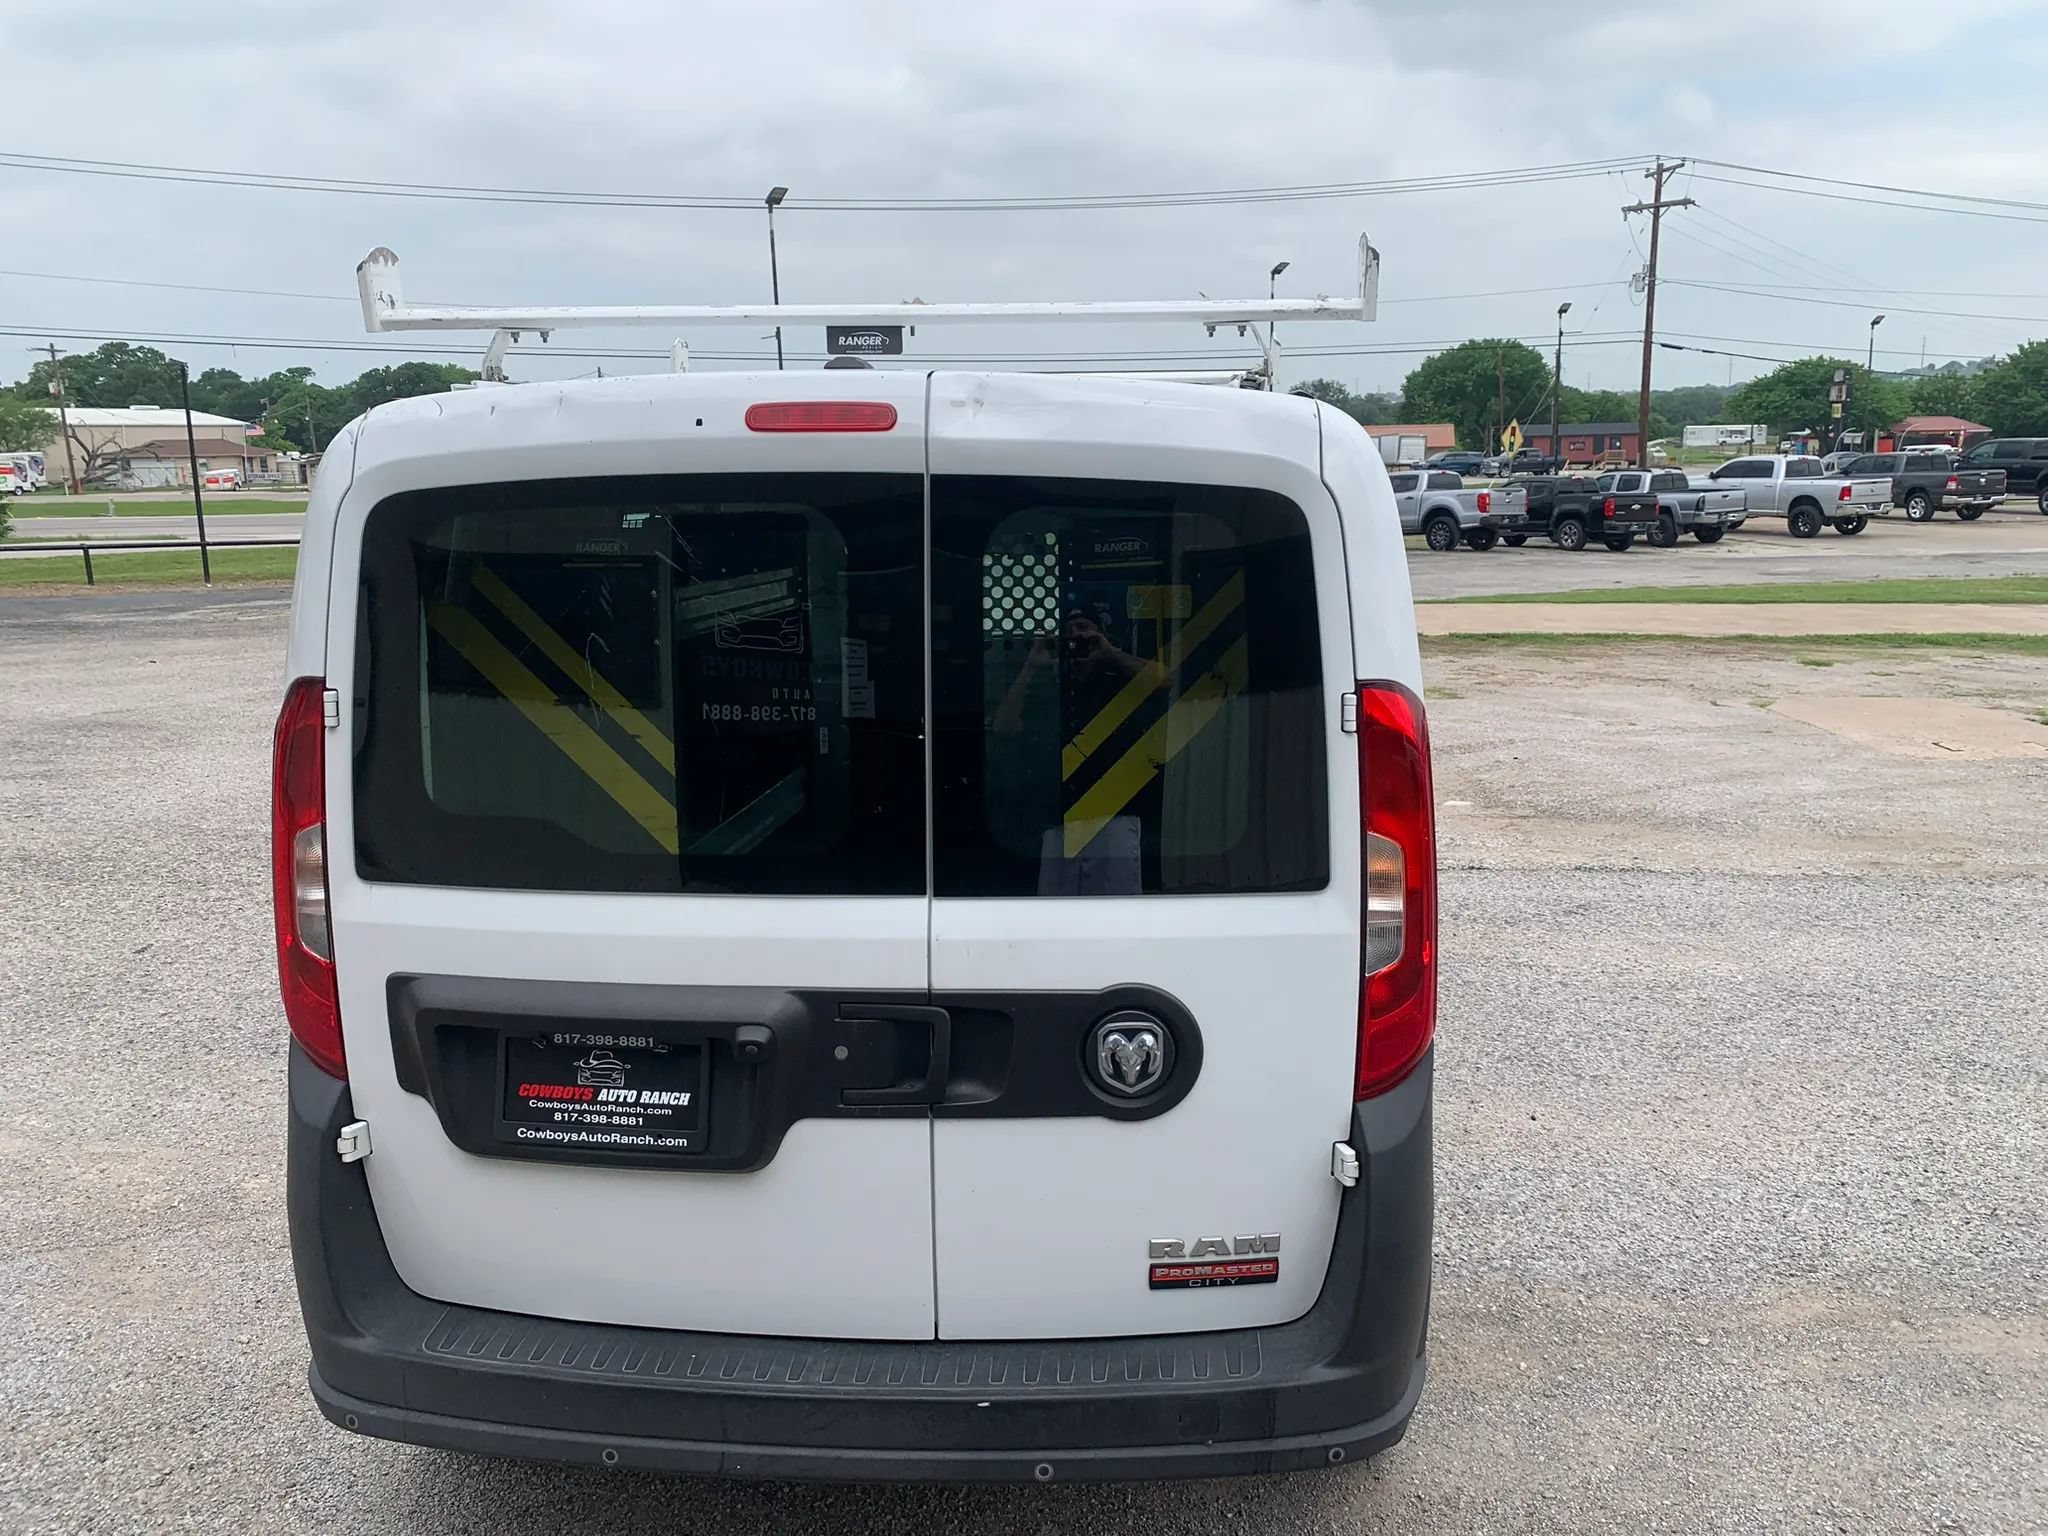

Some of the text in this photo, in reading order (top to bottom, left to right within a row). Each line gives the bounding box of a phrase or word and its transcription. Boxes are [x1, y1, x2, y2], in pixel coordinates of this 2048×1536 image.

[838, 336, 882, 345] RANGER
[576, 543, 620, 552] RANGER
[1094, 541, 1140, 552] RANGER
[553, 1033, 654, 1048] 817-398-8881
[518, 1083, 691, 1106] COWBOYS AUTO RANCH
[528, 1099, 672, 1116] CowboysAutoRanch.com
[553, 1112, 644, 1126] 817-398-8881
[516, 1127, 688, 1147] CowboysAutoRanch.com
[1149, 1232, 1281, 1258] RAM
[1188, 1277, 1240, 1288] CITY
